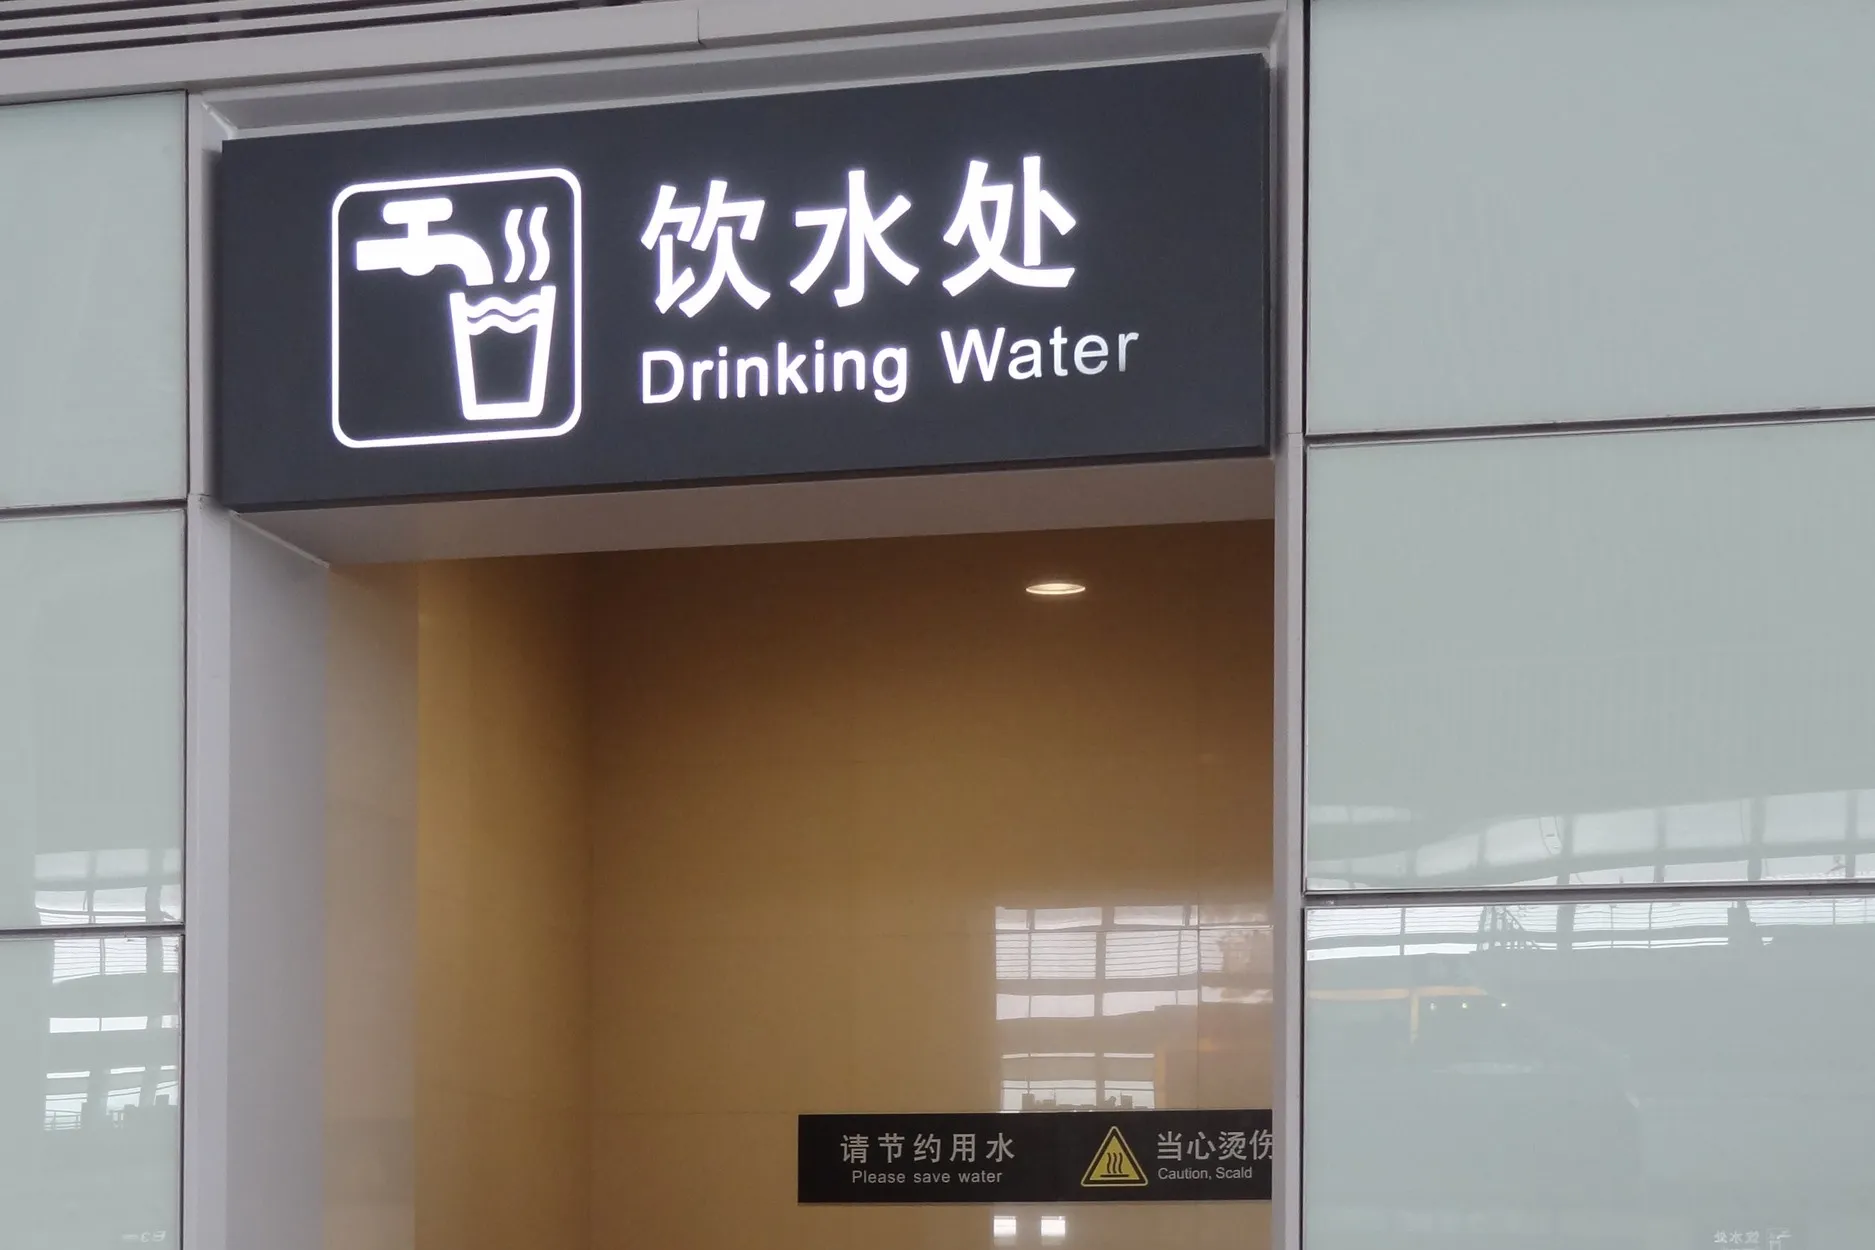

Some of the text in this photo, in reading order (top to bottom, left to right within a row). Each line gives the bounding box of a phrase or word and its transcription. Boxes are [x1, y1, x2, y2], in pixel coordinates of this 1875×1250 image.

[640, 155, 1077, 319] 饮水处
[642, 325, 1140, 404] Drinking Water
[840, 1133, 1015, 1164] 请节约用水
[1157, 1130, 1272, 1161] 当心烫伤
[852, 1170, 1003, 1184] Please save water
[1158, 1166, 1253, 1180] Caution, Scald
